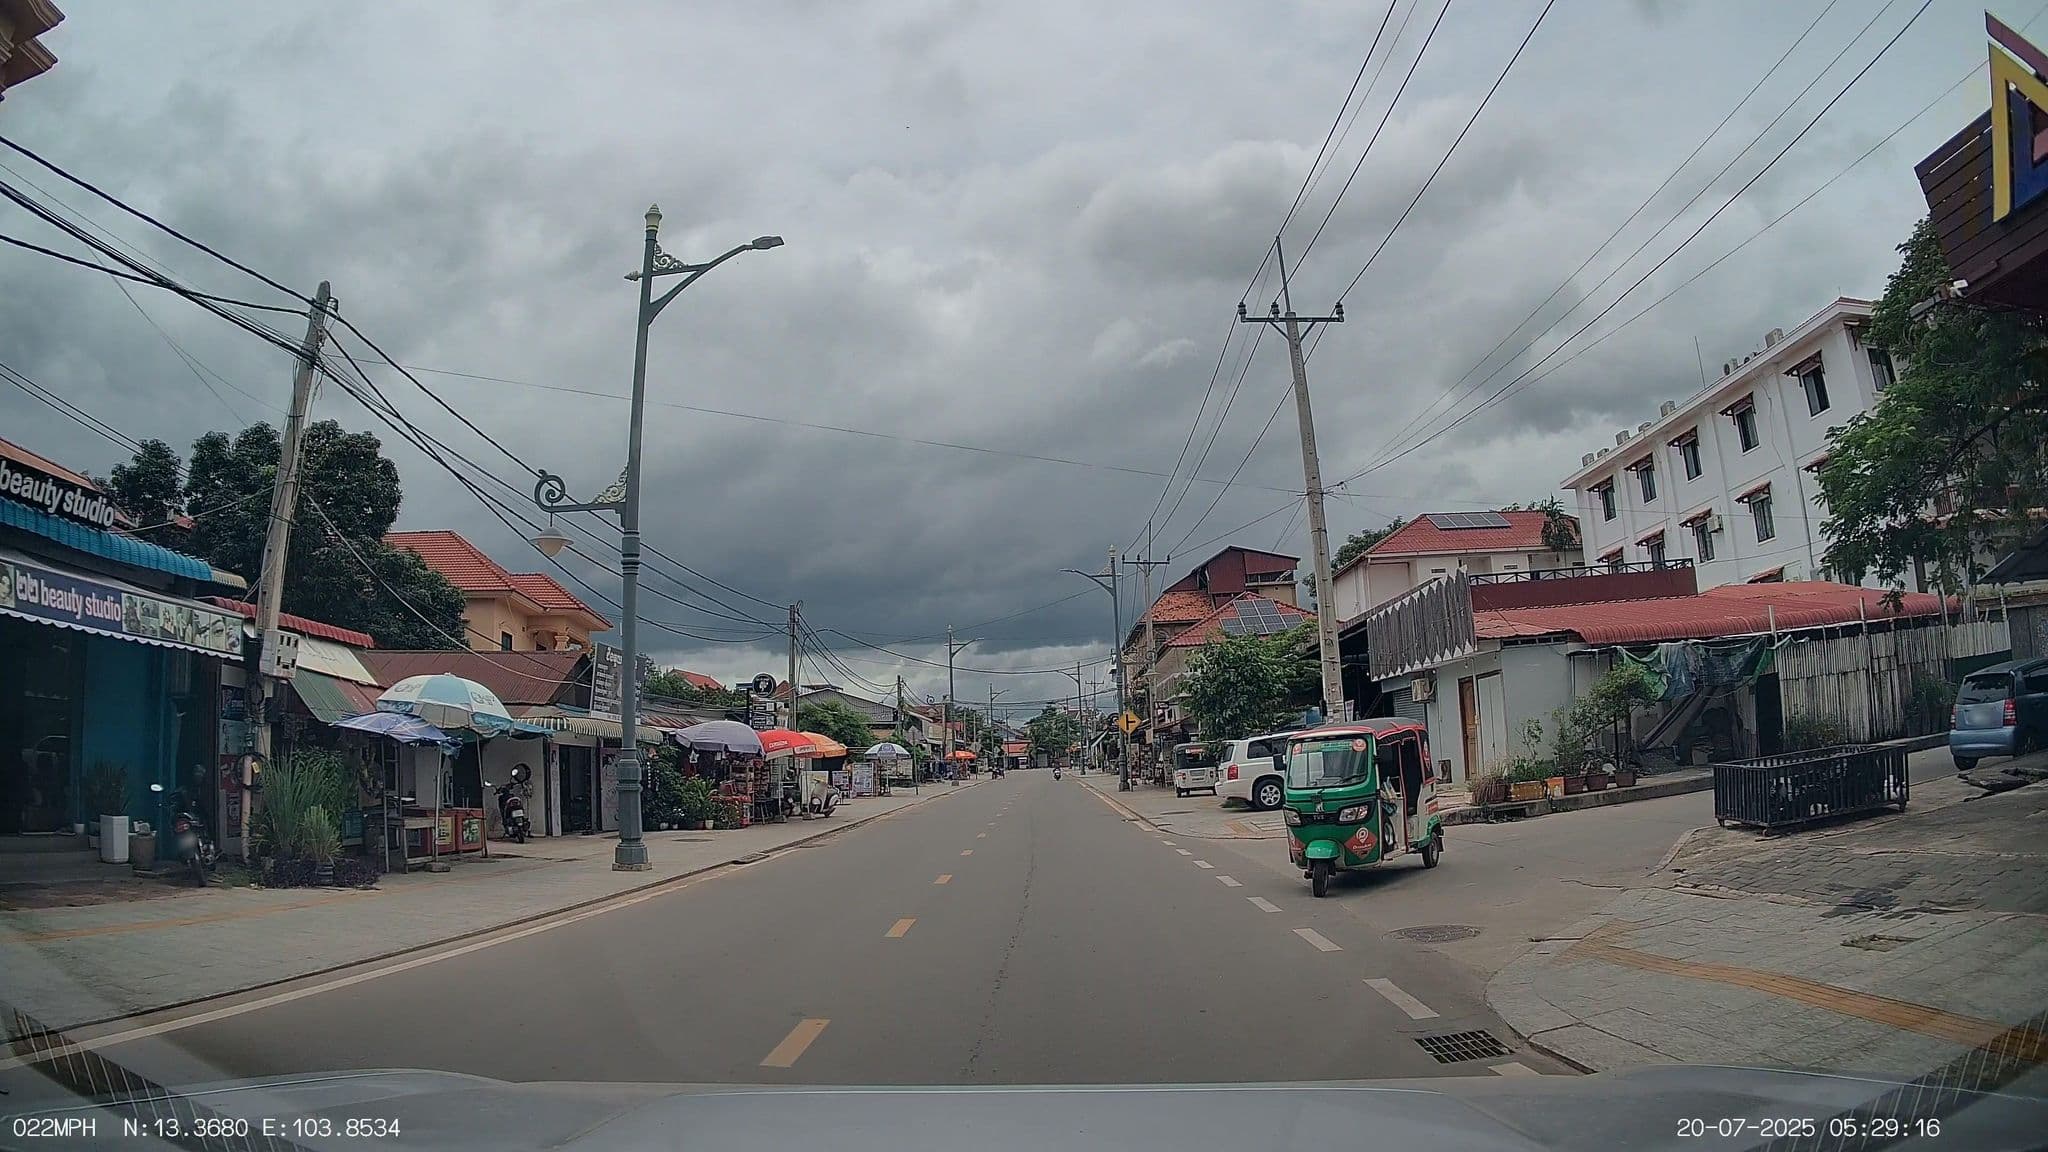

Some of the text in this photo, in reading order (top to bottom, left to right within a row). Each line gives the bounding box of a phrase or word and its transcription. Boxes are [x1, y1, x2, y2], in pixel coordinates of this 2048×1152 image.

[0, 460, 114, 527] beauty studio
[41, 580, 82, 619] beauty
[85, 592, 121, 621] studio
